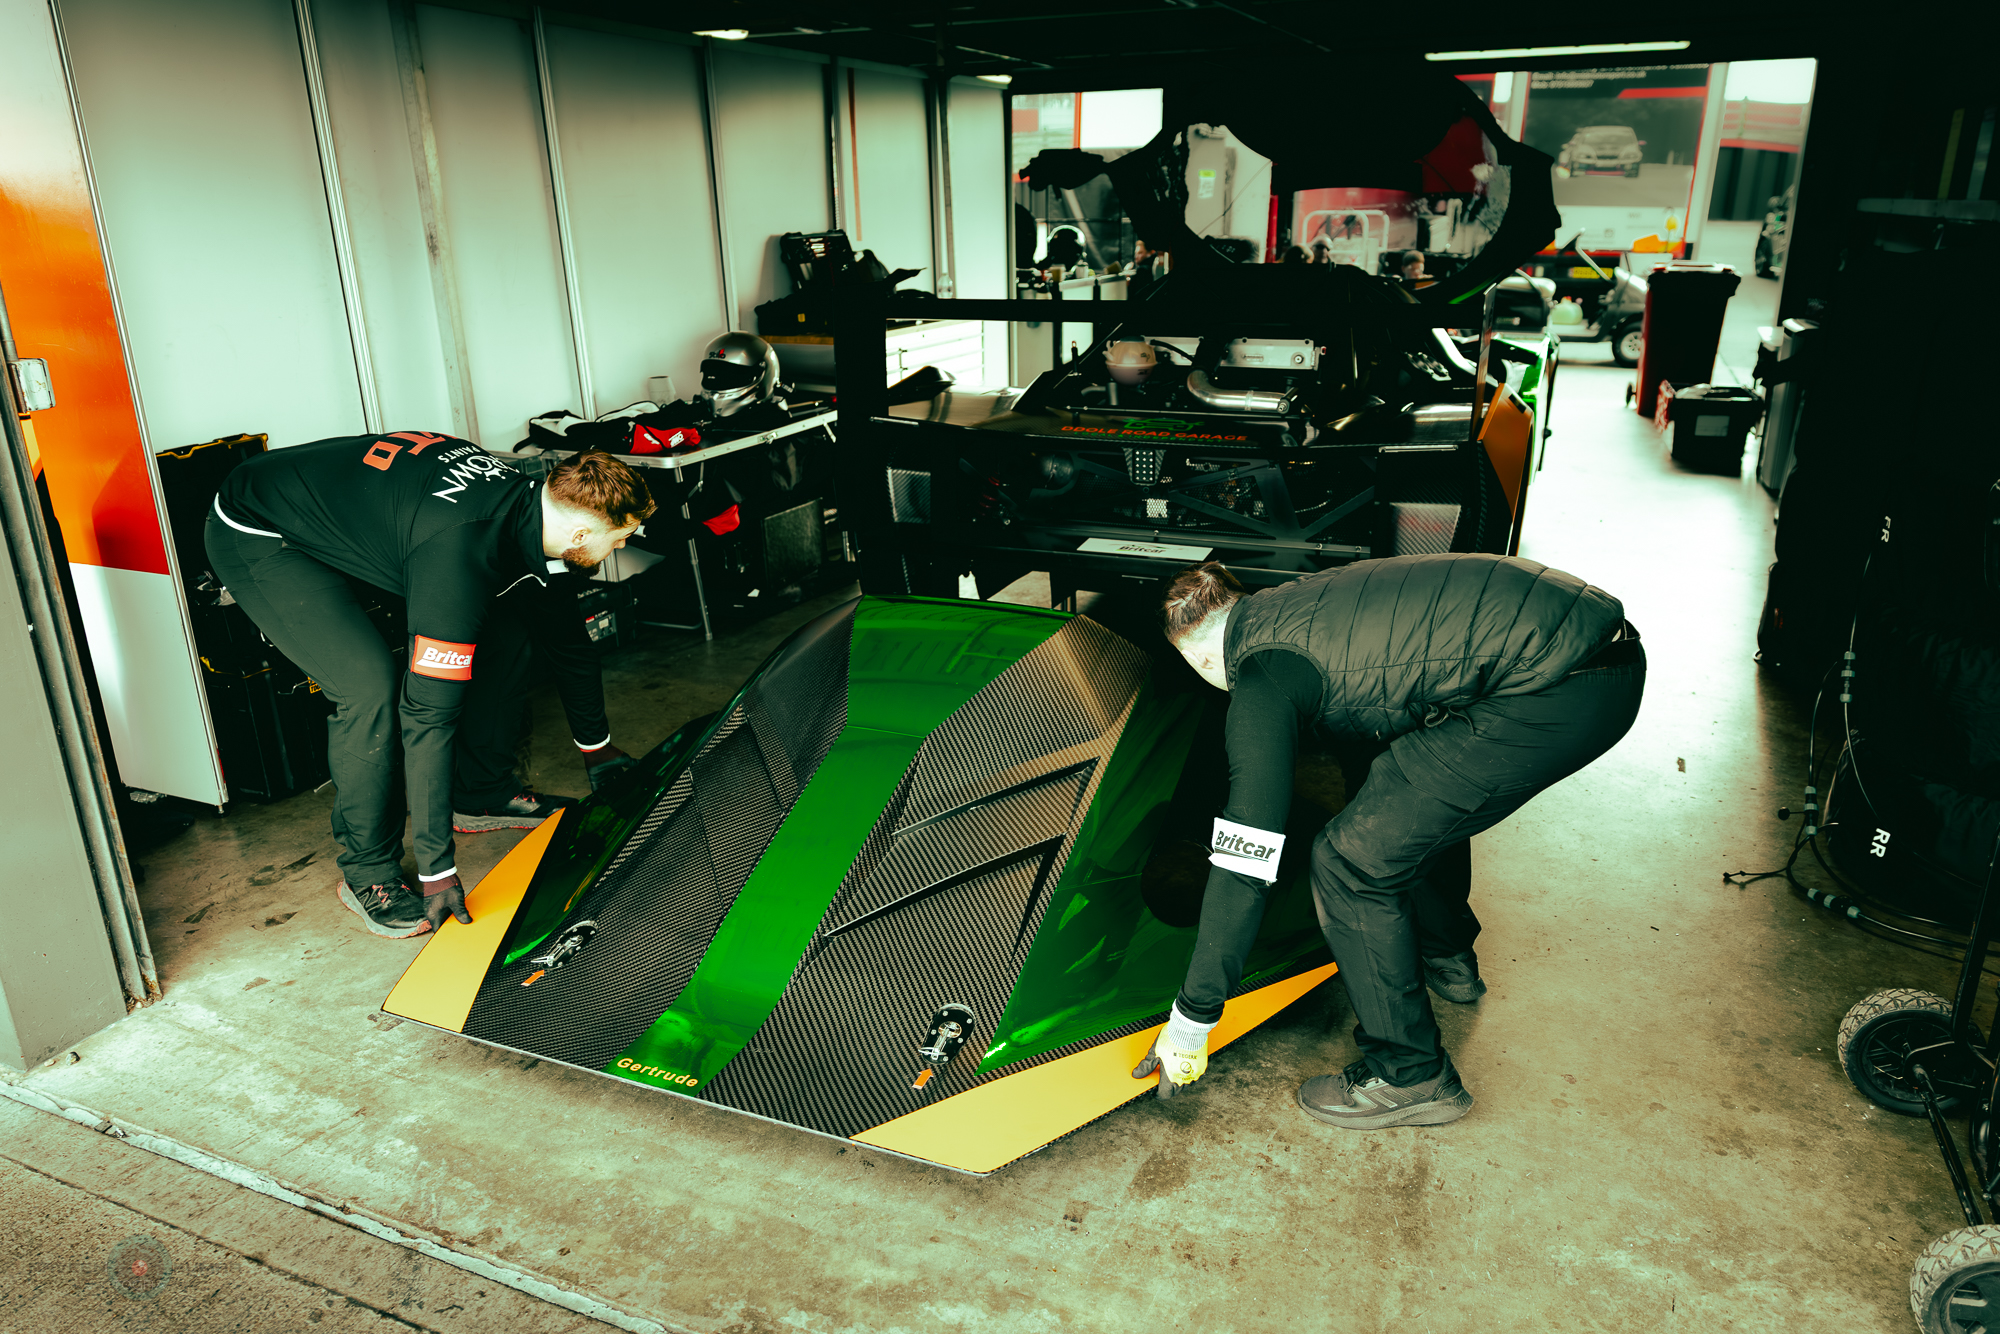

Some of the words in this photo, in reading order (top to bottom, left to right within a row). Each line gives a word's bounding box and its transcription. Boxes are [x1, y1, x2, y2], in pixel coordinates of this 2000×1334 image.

[1121, 429, 1171, 437] ROAD
[1174, 432, 1248, 441] GARAGE
[437, 445, 481, 463] PAINTS
[432, 455, 520, 503] ROWN
[1880, 516, 1891, 542] FR
[1215, 830, 1276, 859] Britcar
[1870, 828, 1891, 858] RR
[616, 1057, 699, 1087] Gertrude
